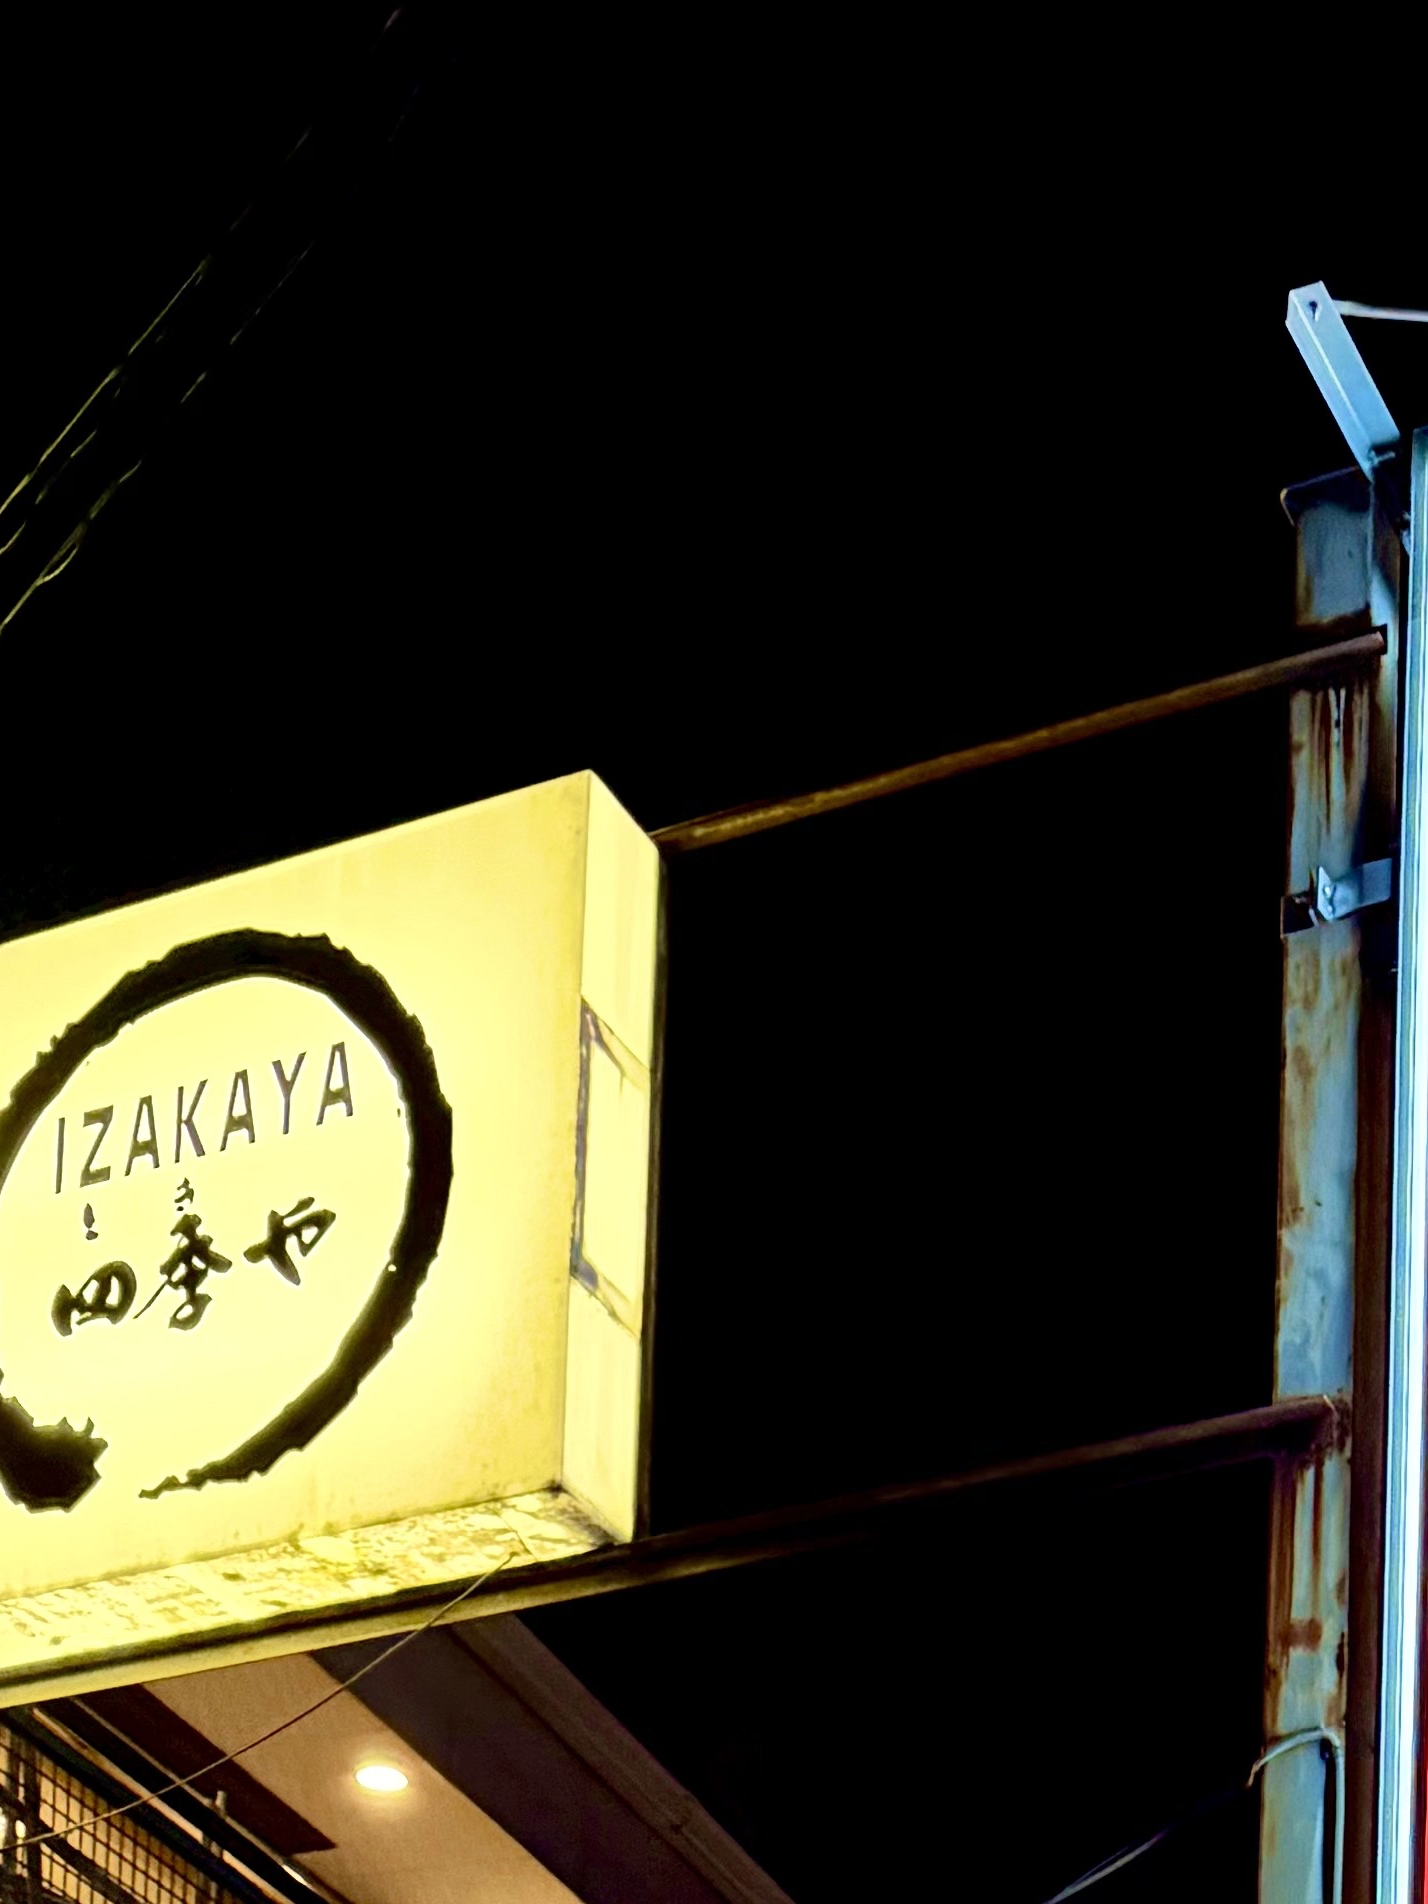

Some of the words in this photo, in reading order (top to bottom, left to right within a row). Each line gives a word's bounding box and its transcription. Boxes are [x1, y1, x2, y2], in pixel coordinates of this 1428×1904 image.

[55, 1042, 353, 1194] IZAKAYA
[51, 1197, 336, 1337] 四季や
